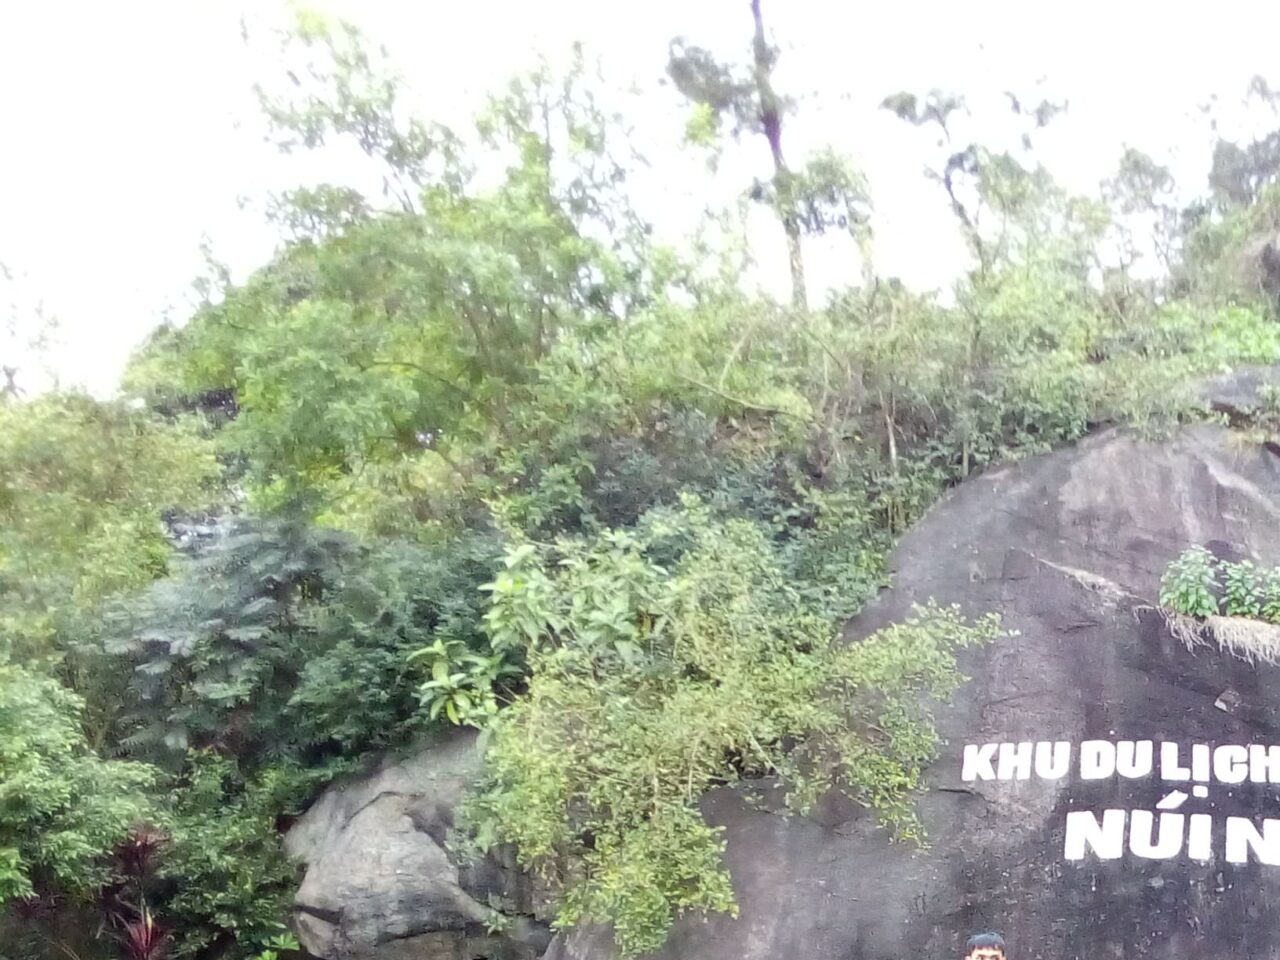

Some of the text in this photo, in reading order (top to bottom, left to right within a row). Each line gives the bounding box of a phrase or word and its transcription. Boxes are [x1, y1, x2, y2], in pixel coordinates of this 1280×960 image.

[961, 740, 1070, 782] KHU
[1080, 740, 1153, 780] DU
[1064, 790, 1211, 861] NÚI
